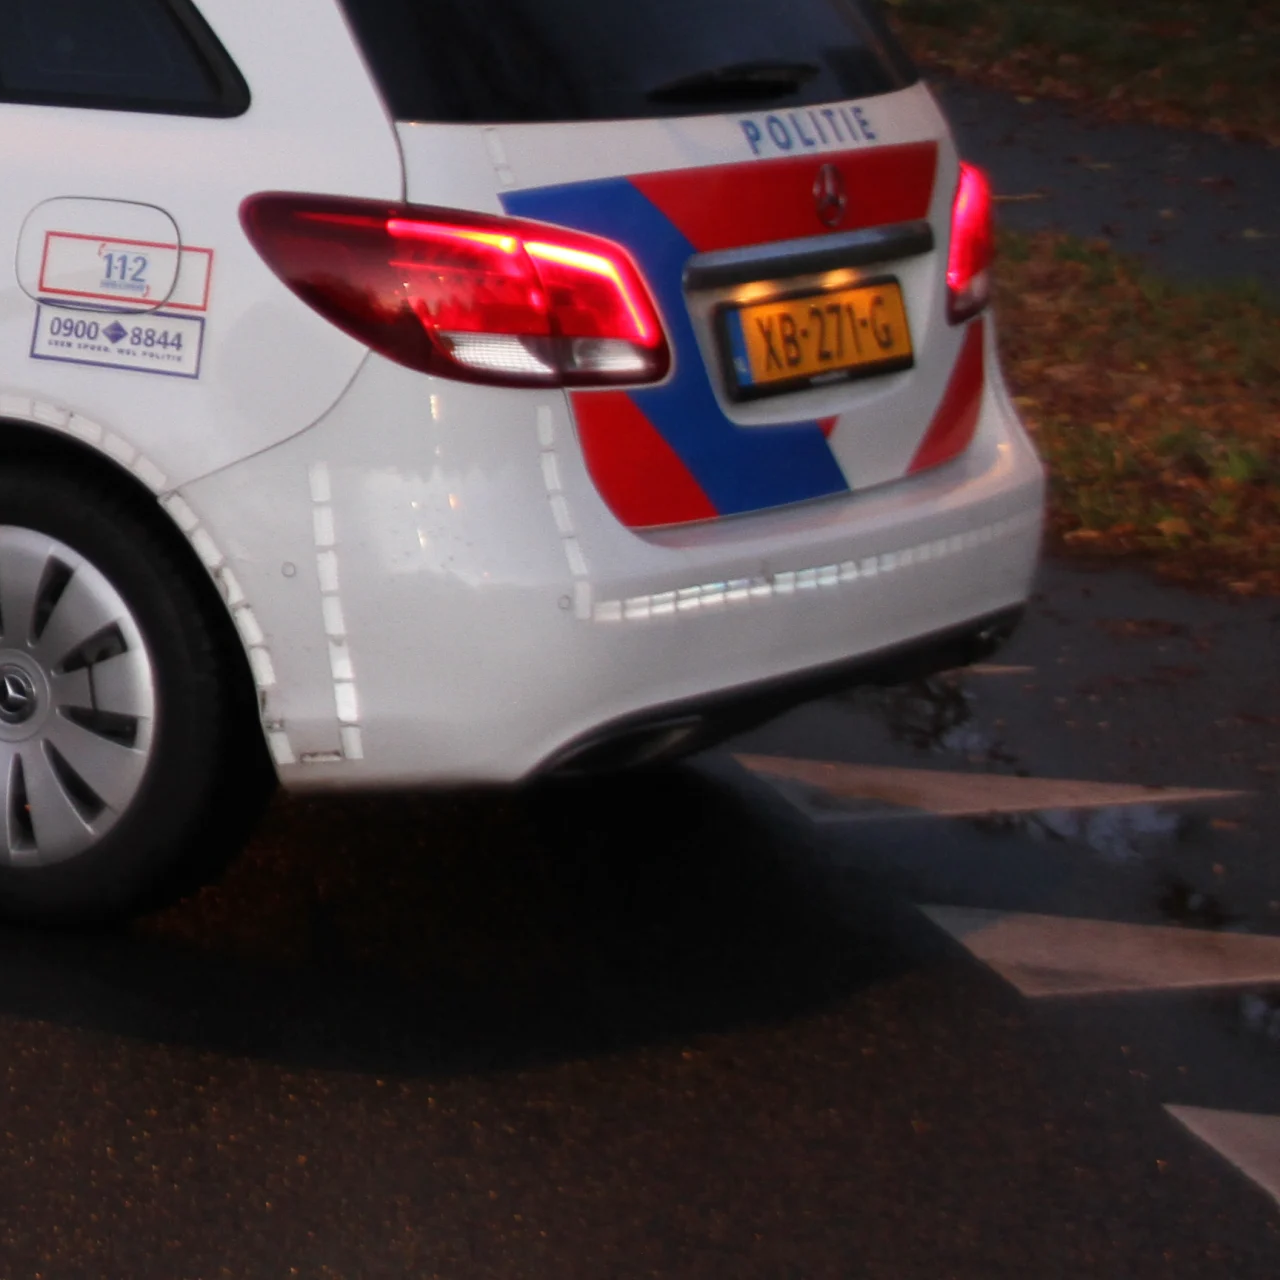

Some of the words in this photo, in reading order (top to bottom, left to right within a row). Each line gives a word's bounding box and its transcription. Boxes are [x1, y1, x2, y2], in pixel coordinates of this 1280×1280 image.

[741, 106, 876, 154] POLITIE
[49, 317, 100, 341] 0900
[129, 326, 183, 350] 8844
[755, 296, 894, 372] XB-271-G
[141, 350, 183, 362] POLITIE
